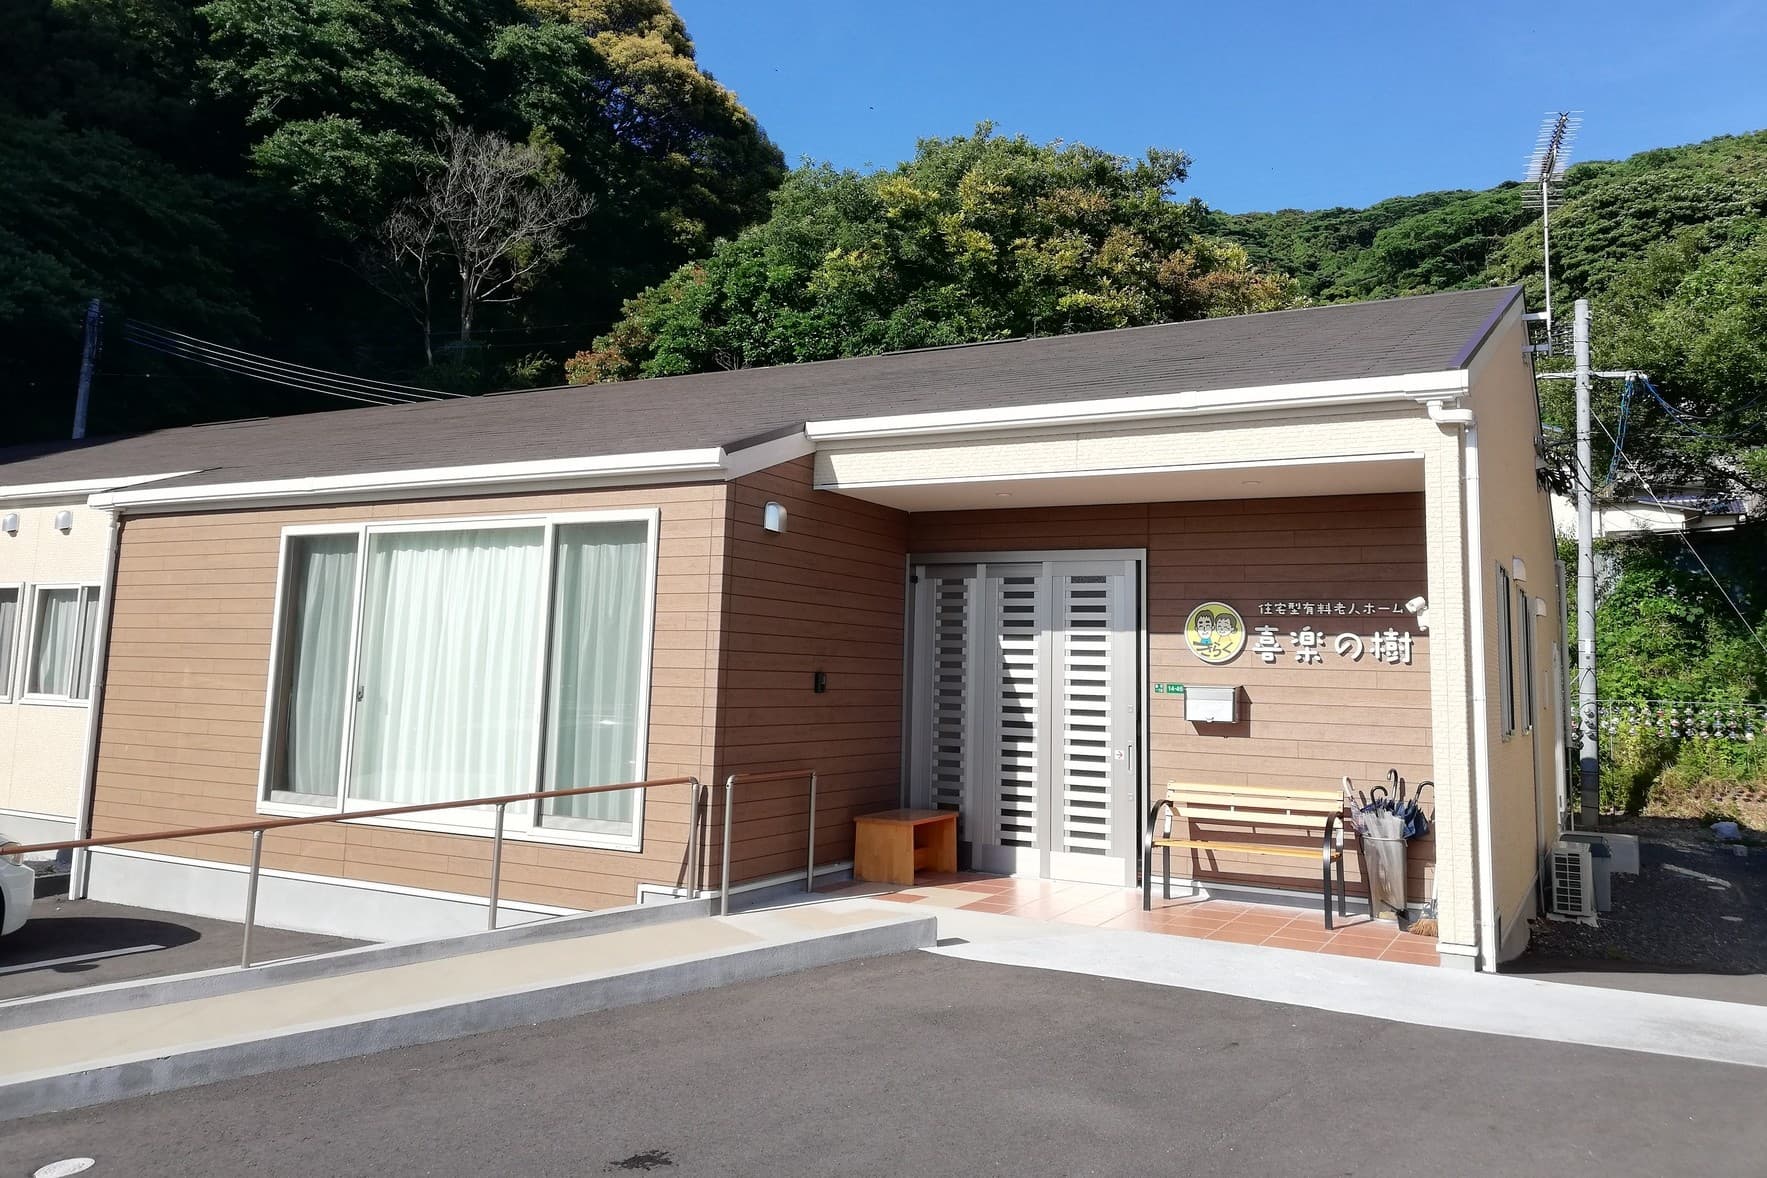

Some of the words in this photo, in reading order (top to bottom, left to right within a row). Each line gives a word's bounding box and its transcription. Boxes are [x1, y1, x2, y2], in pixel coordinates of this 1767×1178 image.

[1258, 602, 1403, 615] 住宅型有料老人ホーム
[1193, 641, 1233, 657] きらく
[1252, 625, 1412, 663] 喜楽の樹
